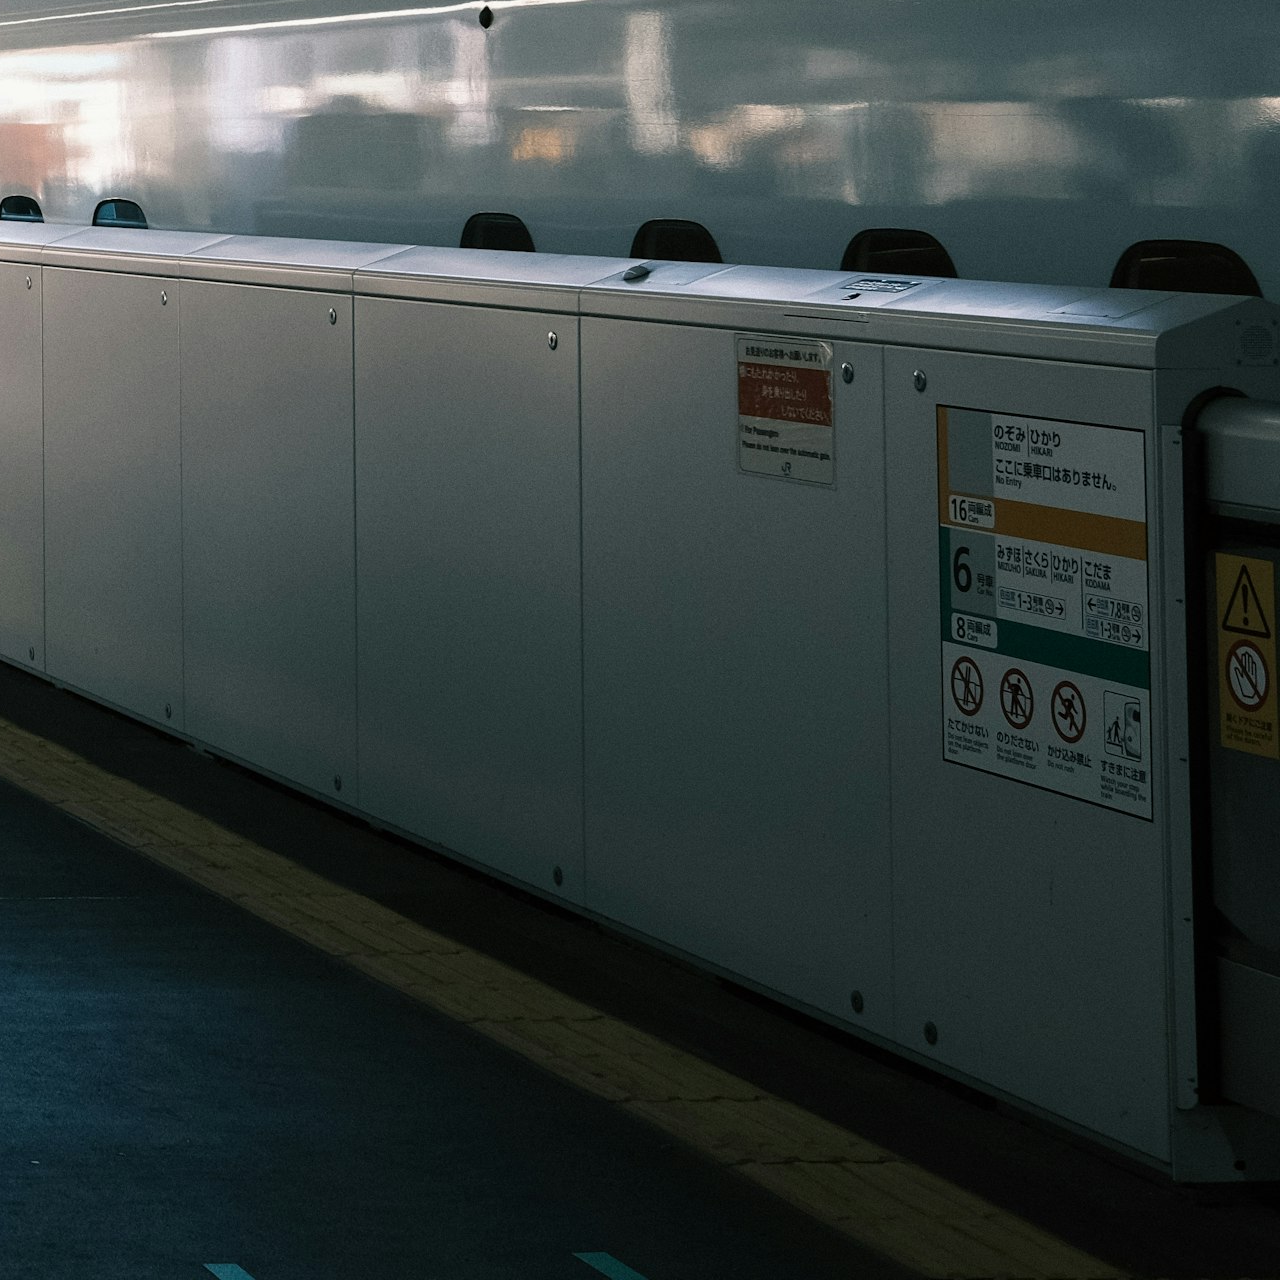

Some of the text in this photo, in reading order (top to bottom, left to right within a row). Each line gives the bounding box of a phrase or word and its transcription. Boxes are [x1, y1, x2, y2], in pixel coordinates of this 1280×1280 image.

[994, 425, 1061, 447] のぞみ ひかり
[995, 441, 1053, 457] NOZOMI HIKARI
[995, 458, 1116, 491] ここに乗車口はありません。
[996, 475, 1022, 489] No Entry
[951, 498, 967, 521] 16
[967, 501, 992, 517] 両編成
[953, 546, 972, 593] 6
[997, 544, 1111, 580] みずほ さくら ひかり こだま
[977, 573, 993, 587] 号車
[997, 561, 1111, 591] MIZUHO SAKURA HIKARI KODAMA
[1017, 593, 1032, 610] 1-3
[957, 617, 966, 638] 8
[967, 619, 991, 636] 両編成
[1100, 621, 1112, 639] 1-3
[947, 718, 988, 738] たてかけない
[996, 731, 1040, 752] のりださない
[1047, 744, 1092, 768] かけ込み禁止
[1100, 760, 1146, 783] すきまに注意
